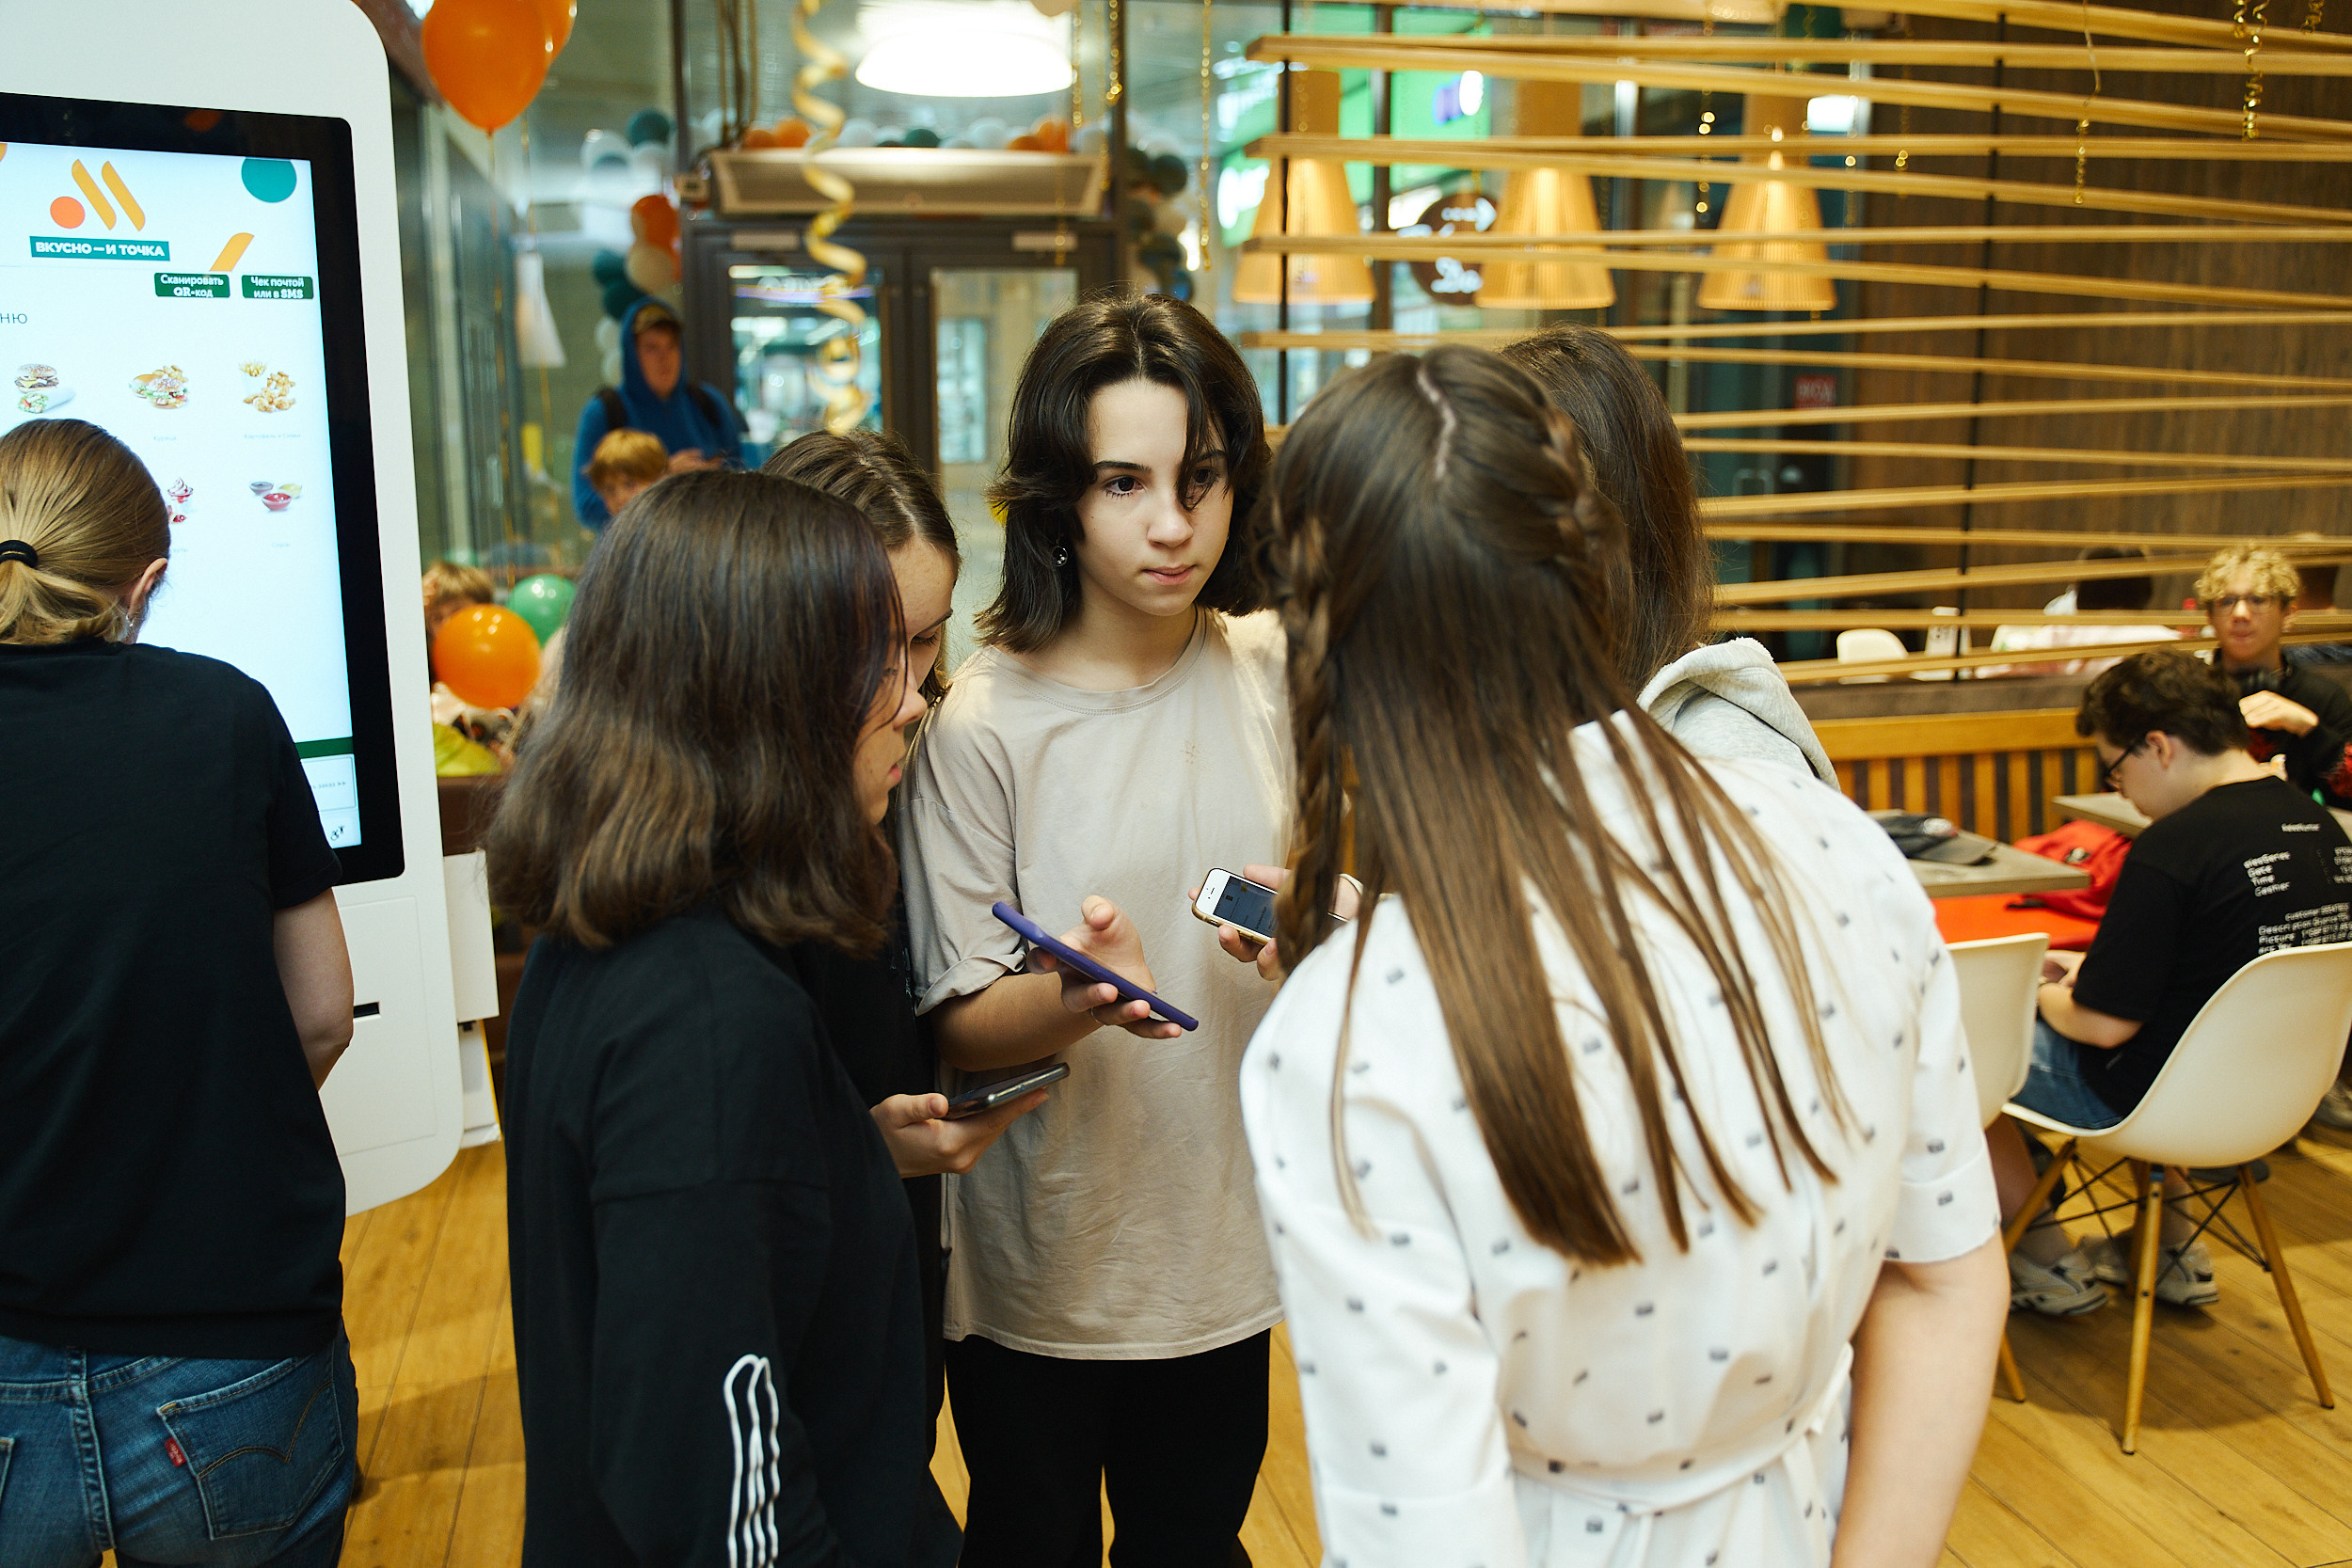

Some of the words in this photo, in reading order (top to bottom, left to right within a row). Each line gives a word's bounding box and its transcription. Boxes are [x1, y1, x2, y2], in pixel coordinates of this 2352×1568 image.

[118, 244, 166, 257] ТОЧКА
[160, 274, 224, 286] Сканировать
[250, 276, 269, 287] Чек
[270, 277, 305, 288] почтой
[173, 287, 214, 298] QR-код
[253, 290, 272, 298] или
[273, 290, 279, 298] в
[280, 289, 304, 299] SMS
